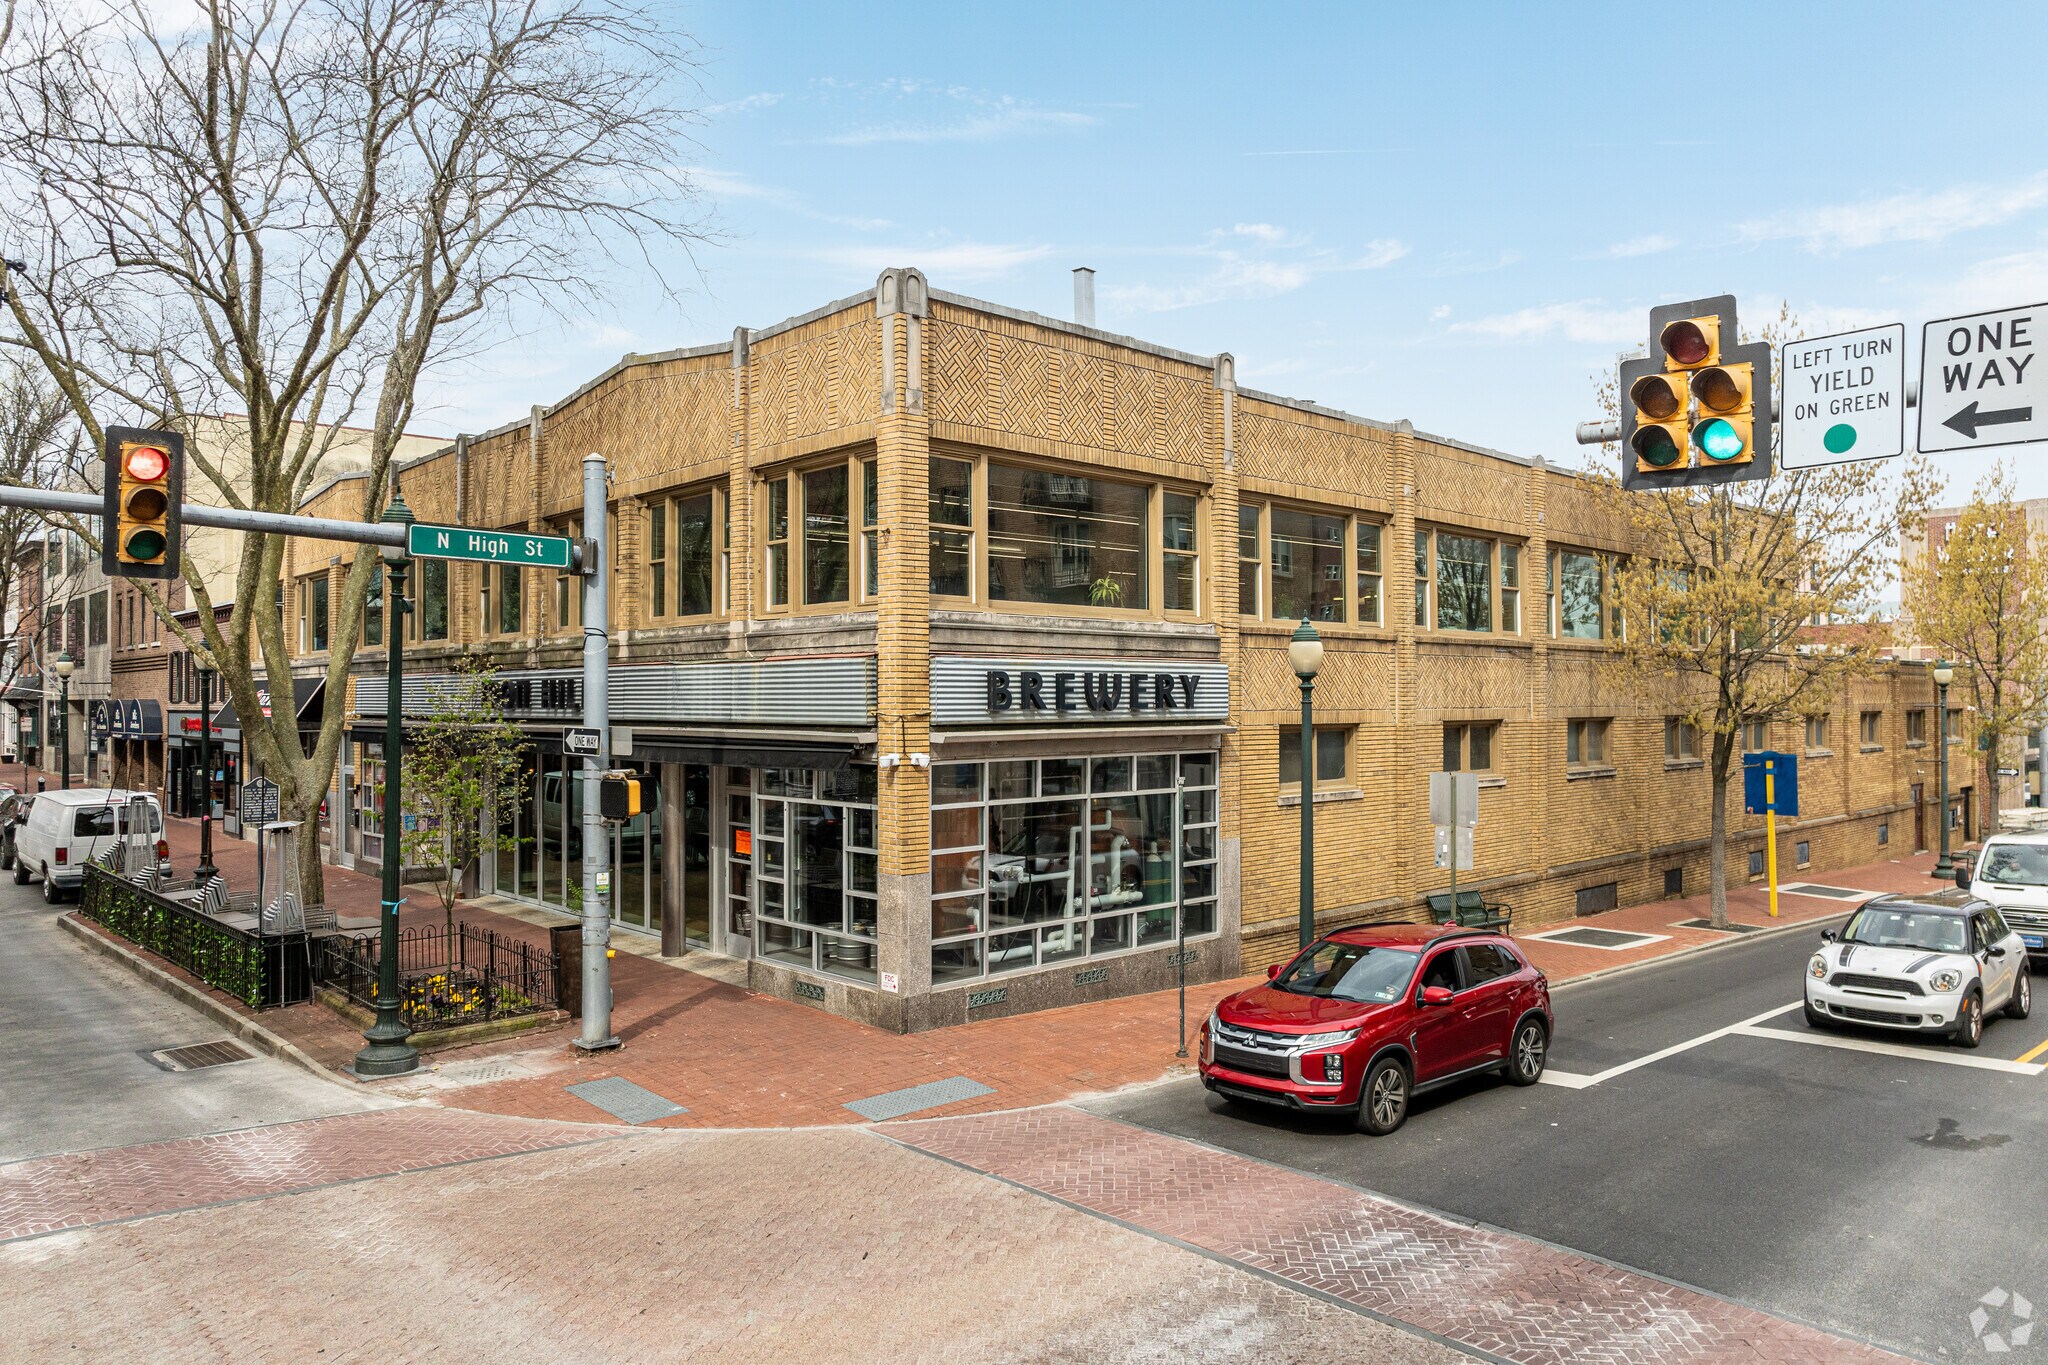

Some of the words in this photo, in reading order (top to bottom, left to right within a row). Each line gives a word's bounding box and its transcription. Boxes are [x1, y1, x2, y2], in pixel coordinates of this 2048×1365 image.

[1947, 317, 2032, 356] ONE
[1793, 348, 1833, 370] LEFT
[1842, 337, 1893, 361] TURN
[1810, 366, 1875, 394] YIELD
[1942, 353, 2035, 394] WAY
[1794, 402, 1818, 420] ON
[1830, 391, 1890, 415] GREEN
[438, 532, 450, 548] N
[469, 534, 509, 558] High
[525, 540, 544, 557] St
[987, 671, 1200, 711] BREWERY
[574, 735, 585, 747] ONE
[586, 736, 598, 747] WAY
[884, 974, 894, 982] FDC
